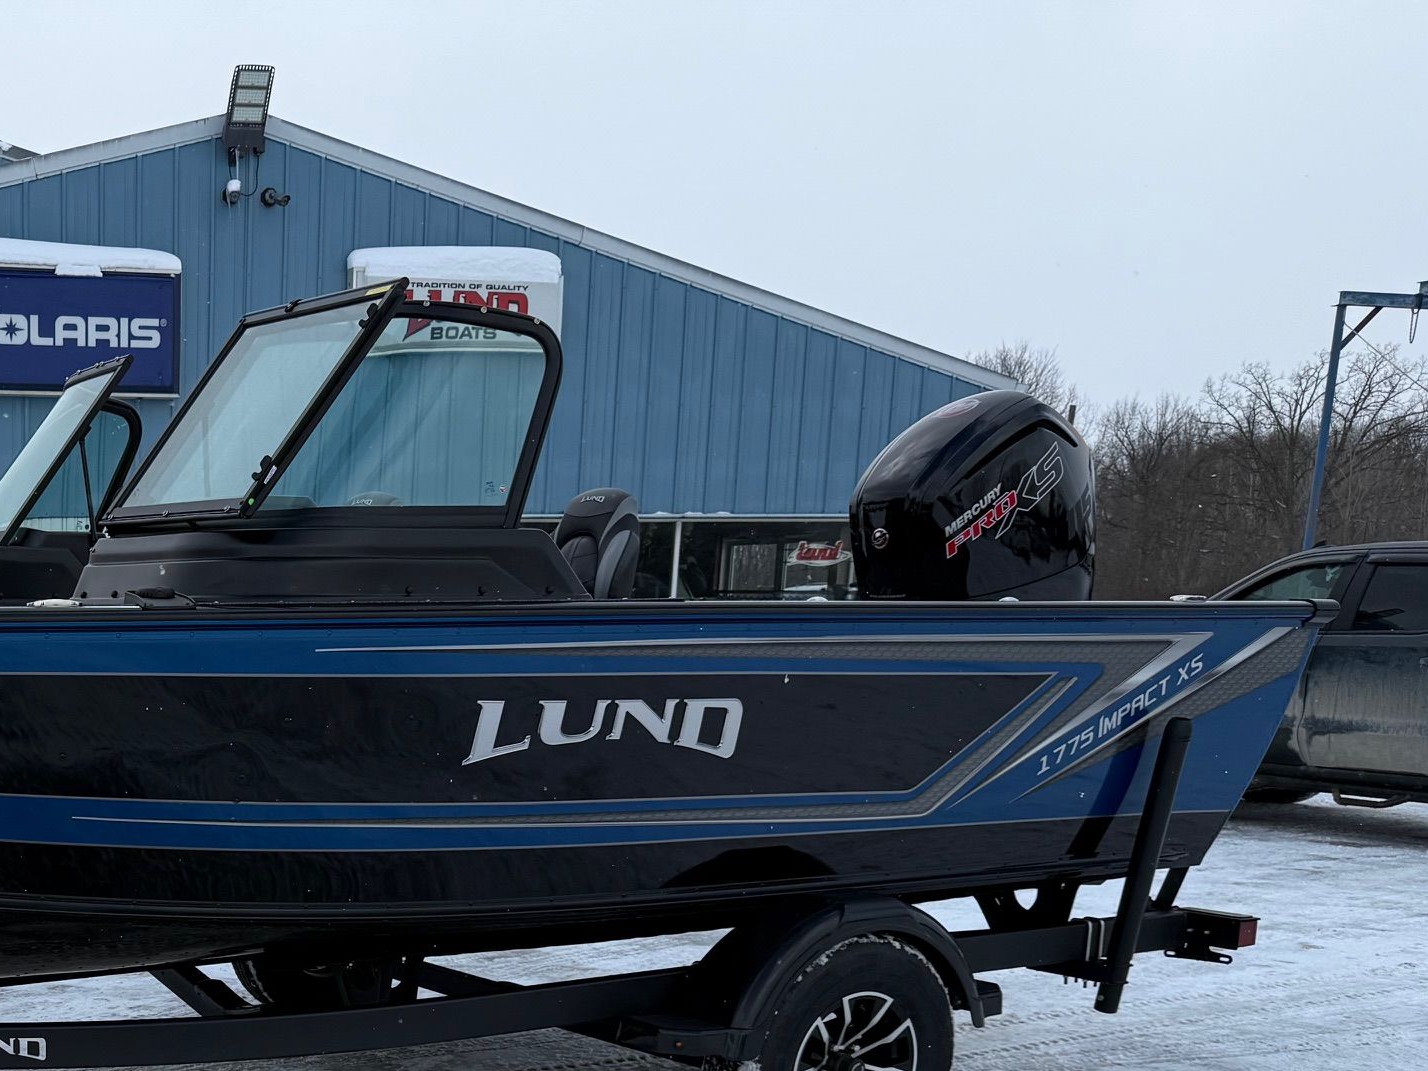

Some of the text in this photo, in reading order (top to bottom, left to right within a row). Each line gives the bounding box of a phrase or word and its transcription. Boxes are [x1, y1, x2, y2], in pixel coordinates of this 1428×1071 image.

[485, 284, 529, 292] QUALITY
[430, 326, 497, 340] BOATS
[945, 482, 1002, 537] MERCURY
[461, 697, 743, 766] LUND
[1037, 726, 1094, 776] 1775
[1177, 653, 1204, 686] XS
